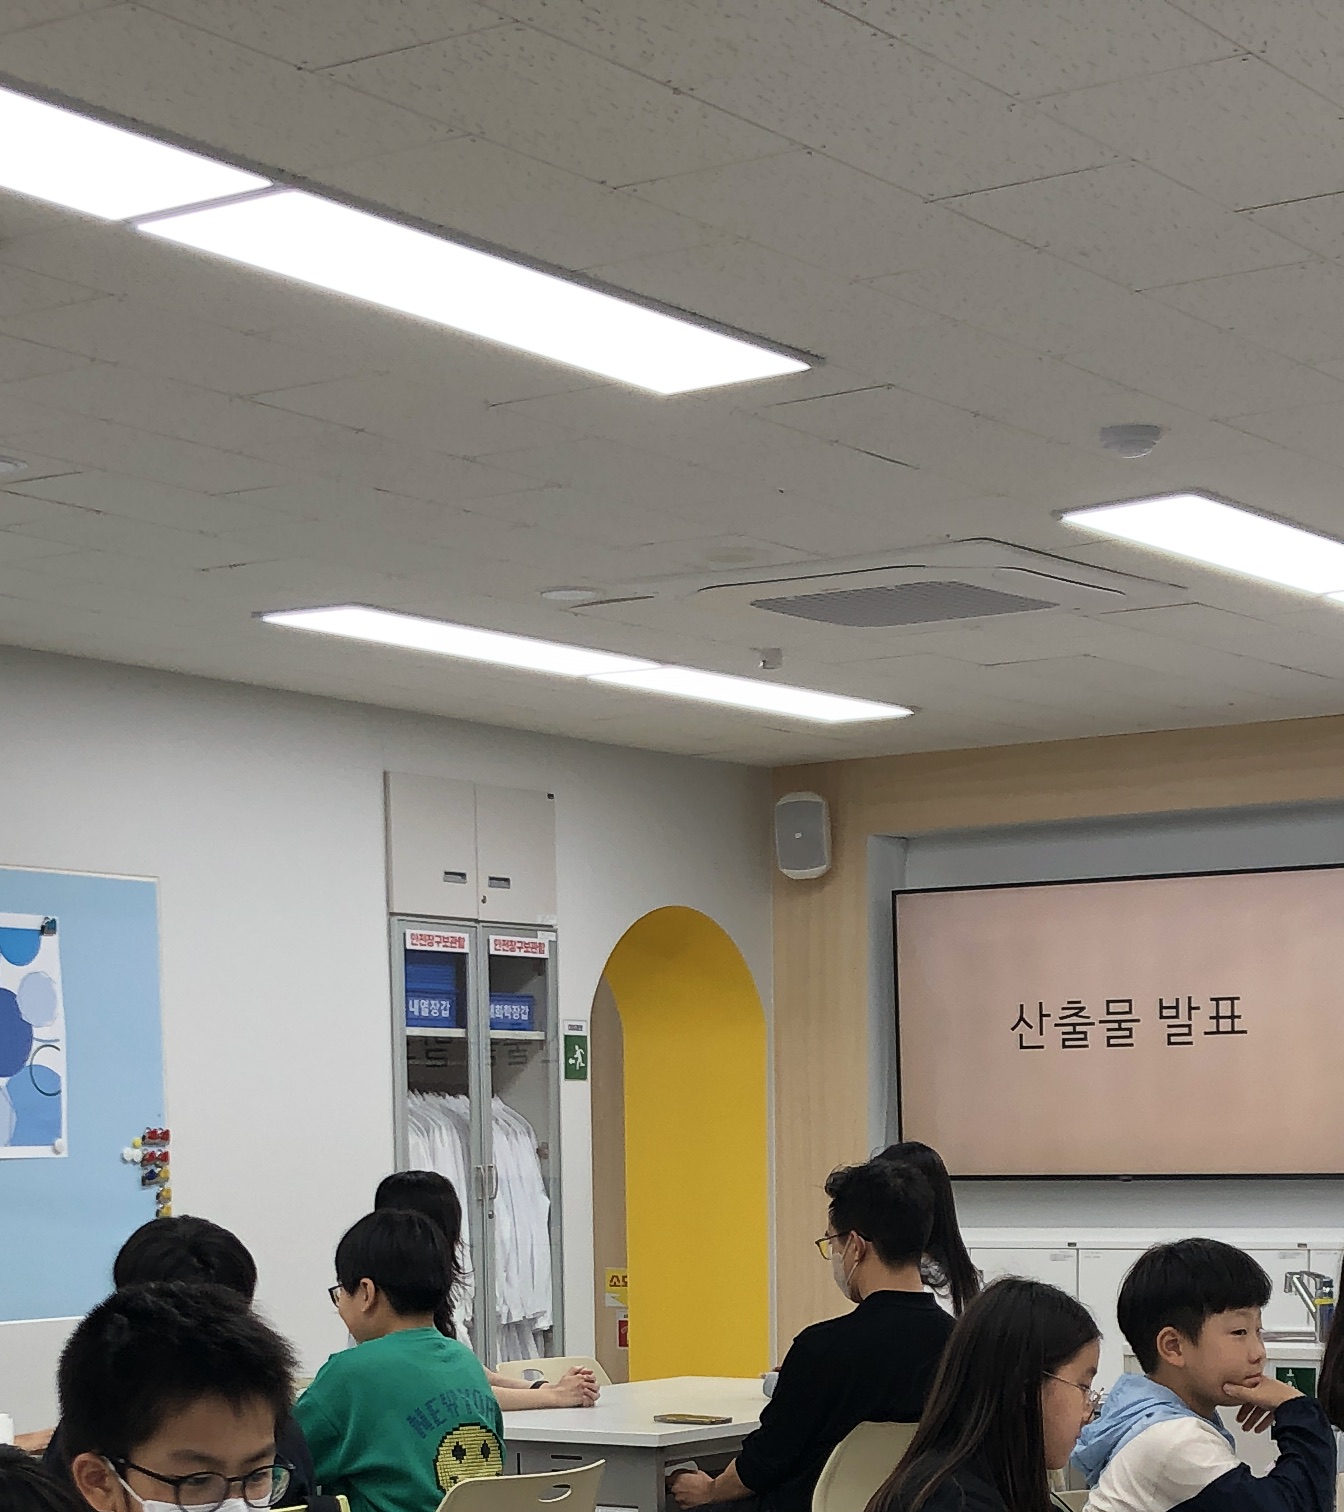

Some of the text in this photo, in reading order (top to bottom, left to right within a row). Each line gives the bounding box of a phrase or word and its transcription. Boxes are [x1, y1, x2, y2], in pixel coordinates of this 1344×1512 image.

[408, 999, 452, 1018] 내열장갑
[1010, 995, 1249, 1051] 산출물 발표
